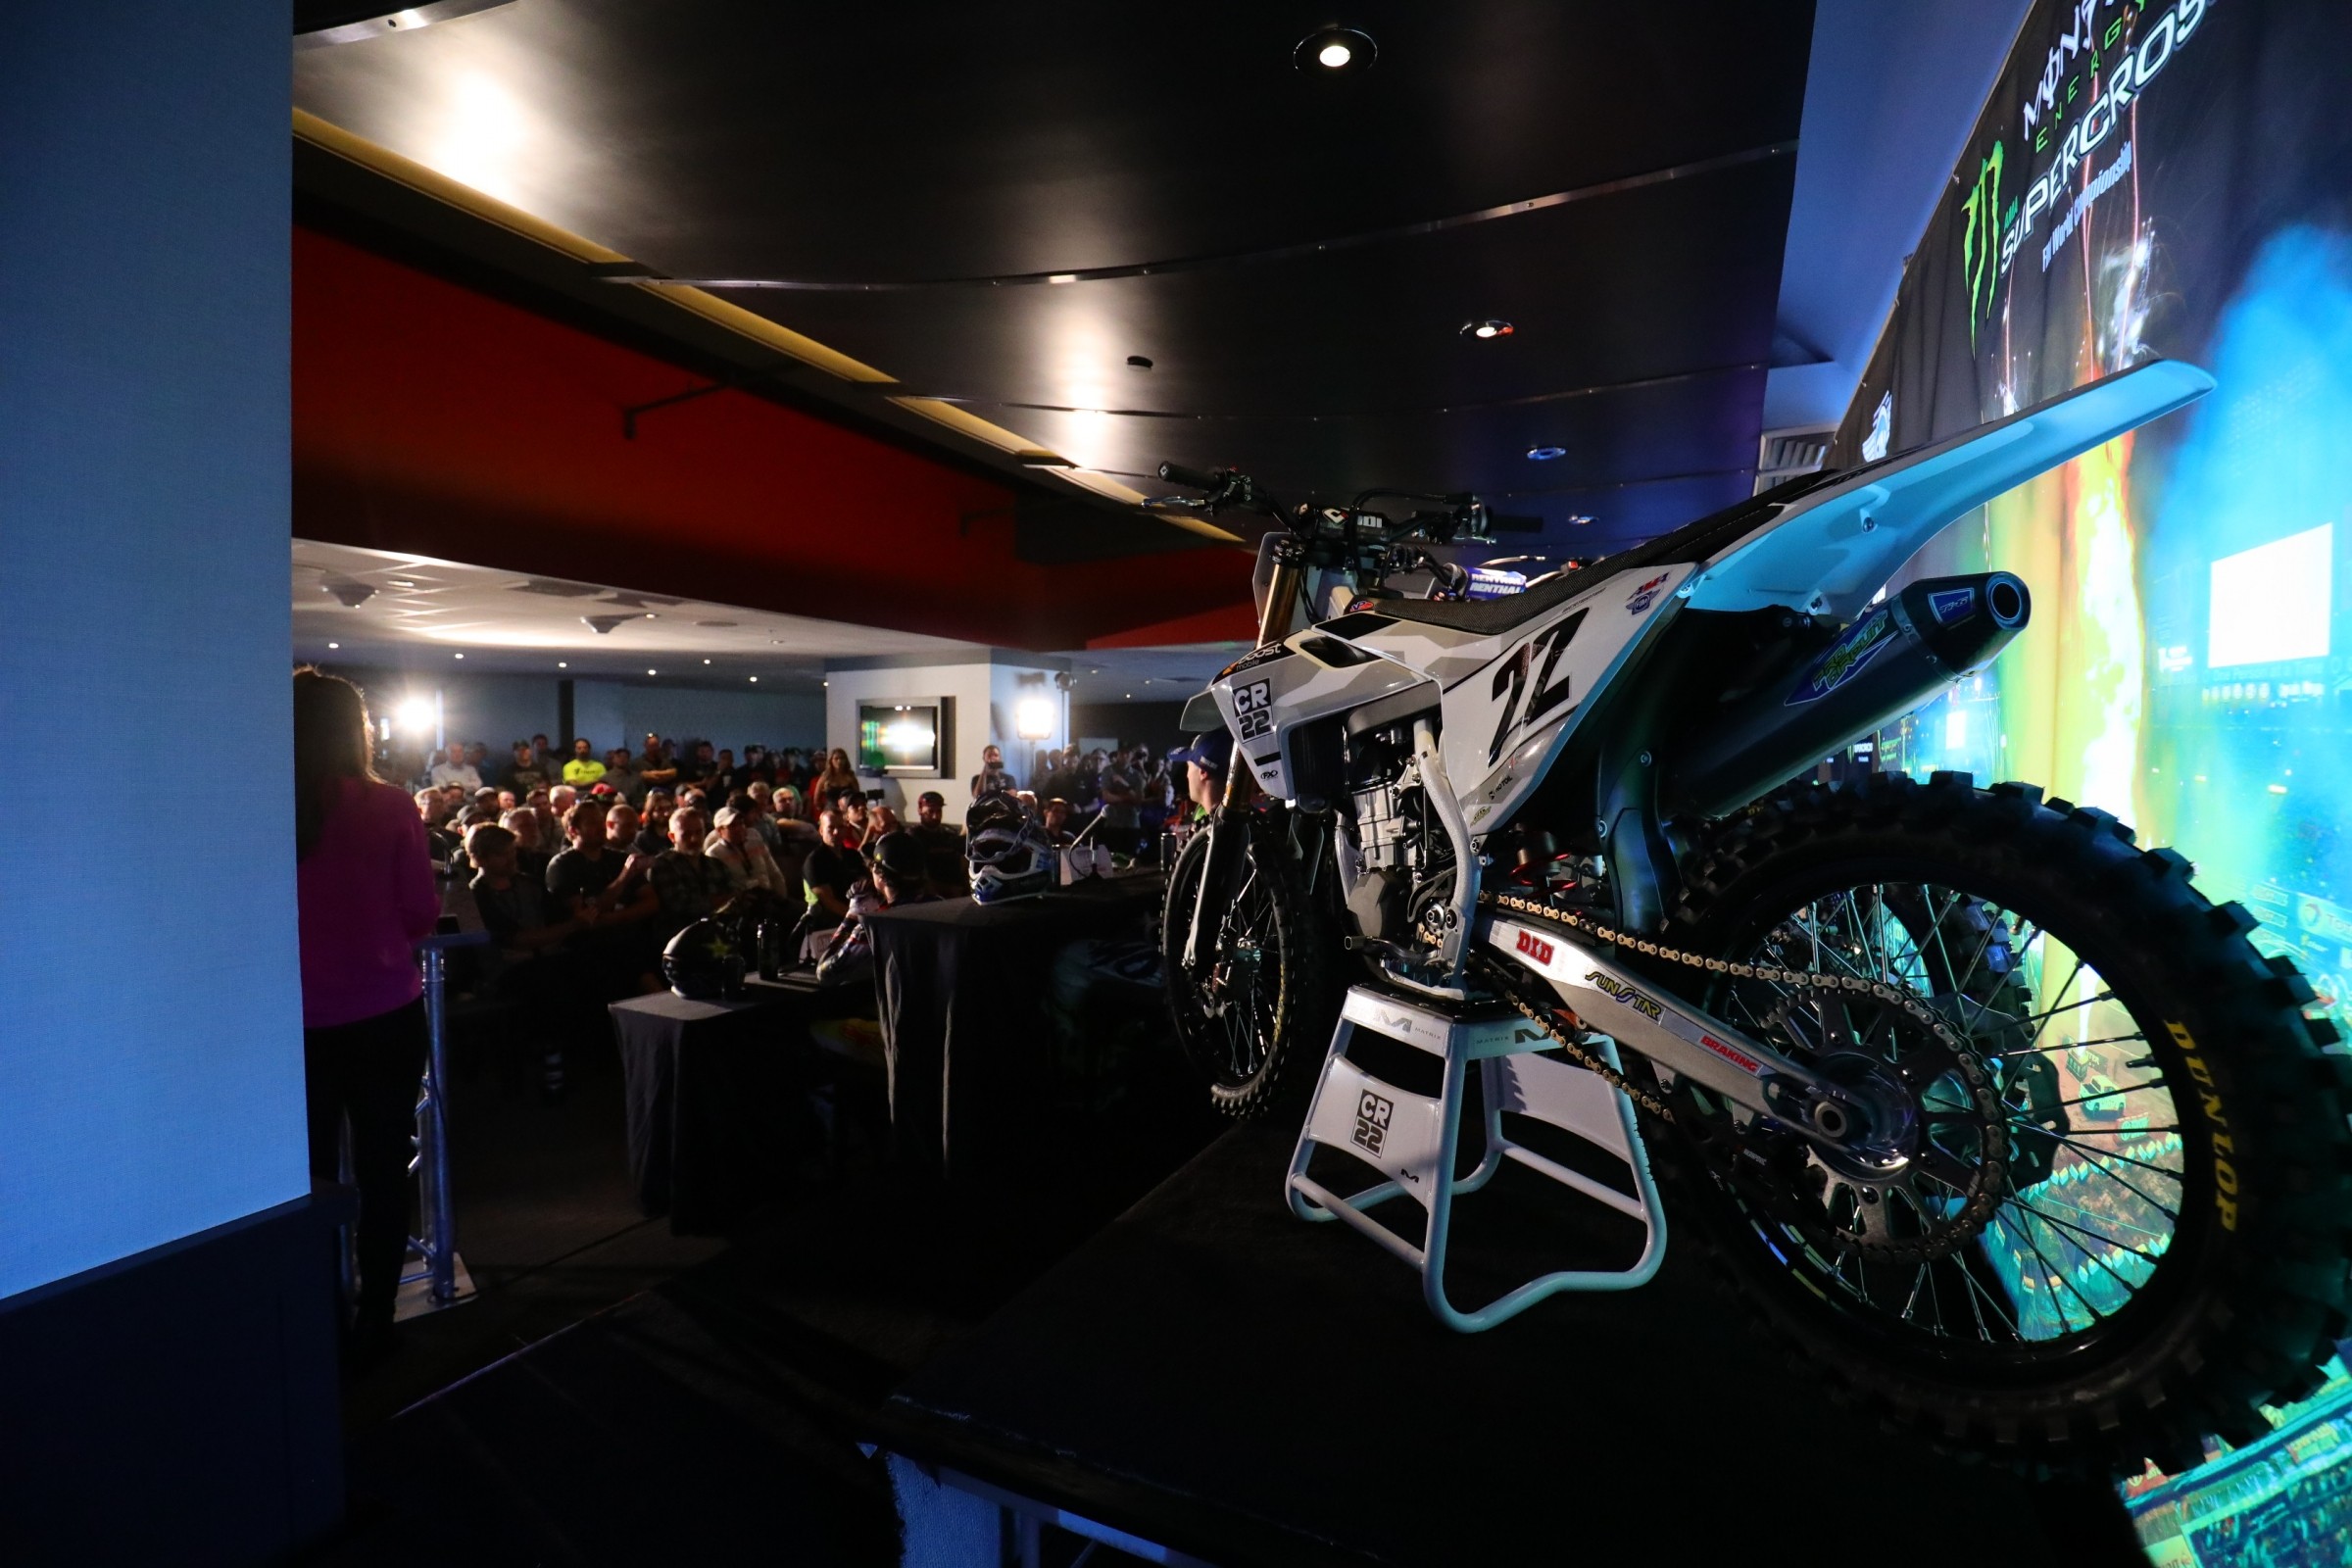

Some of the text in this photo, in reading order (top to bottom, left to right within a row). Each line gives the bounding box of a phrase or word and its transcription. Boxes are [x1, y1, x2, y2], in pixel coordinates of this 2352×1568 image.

[2023, 0, 2115, 141] MONS
[2000, 0, 2209, 275] SUPERCROS
[1235, 682, 1269, 713] CR
[1238, 710, 1271, 741] 22
[1414, 1027, 1442, 1040] MATRIX
[1475, 1035, 1510, 1045] MATRIX
[1699, 1034, 1759, 1073] BRAKING
[1360, 1094, 1391, 1128] CR
[2164, 1019, 2238, 1232] DUNLOP
[1352, 1118, 1384, 1154] 22
